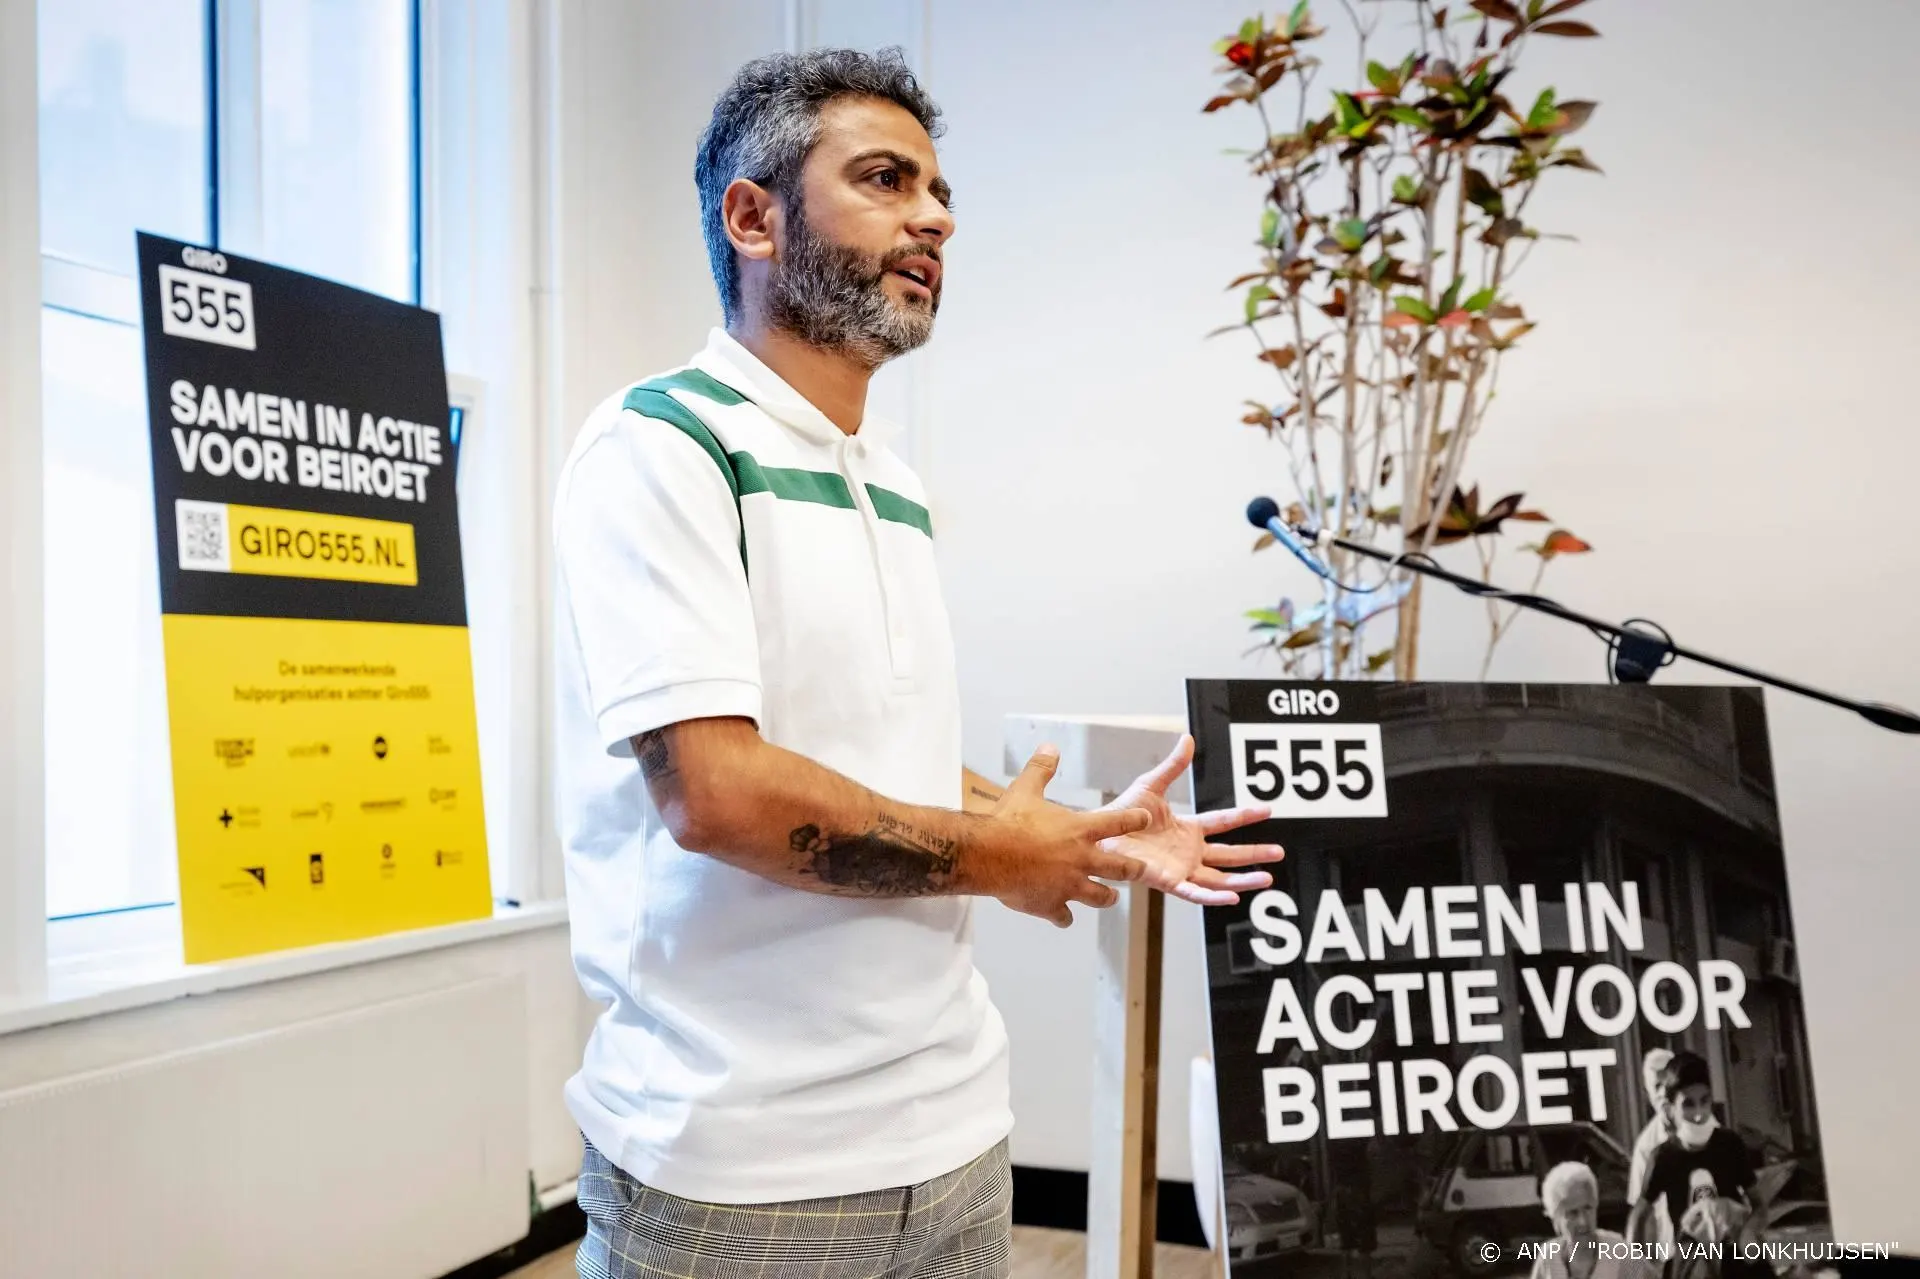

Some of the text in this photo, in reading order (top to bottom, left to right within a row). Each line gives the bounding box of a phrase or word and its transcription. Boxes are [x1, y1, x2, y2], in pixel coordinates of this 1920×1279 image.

[181, 246, 228, 274] GIRO
[170, 279, 246, 334] 555
[169, 379, 443, 465] SAMEN IN ACTIE
[170, 426, 430, 503] VOOR BEIROET
[240, 524, 406, 568] GIRO555.NL
[1267, 688, 1340, 716] GIRO
[1244, 739, 1374, 801] 555
[1249, 881, 1644, 965] SAMEN IN
[1255, 960, 1752, 1054] ACTIE VOOR
[1262, 1048, 1617, 1144] BEIROET
